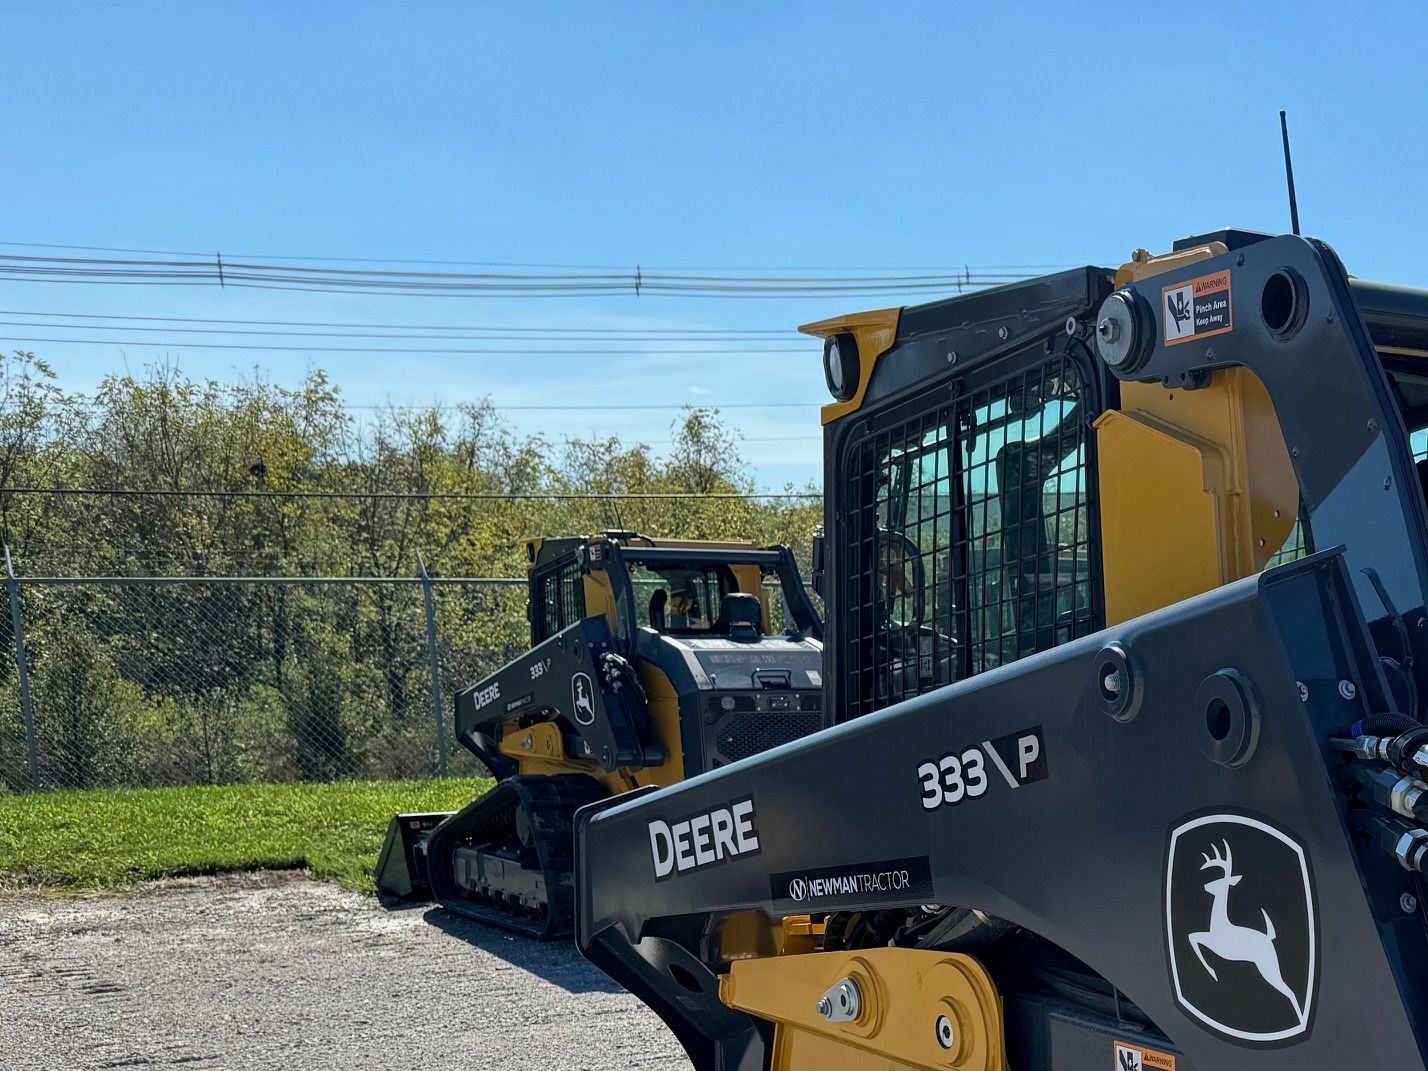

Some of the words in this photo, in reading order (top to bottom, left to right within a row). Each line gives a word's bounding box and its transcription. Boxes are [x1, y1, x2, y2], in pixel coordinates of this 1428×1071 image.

[1200, 277, 1227, 291] WARNING
[1196, 302, 1212, 314] Pinch
[1213, 300, 1227, 310] Area
[1196, 317, 1209, 326] Keep
[1209, 314, 1223, 323] Away
[473, 682, 501, 710] DEERE
[648, 800, 759, 877] DEERE
